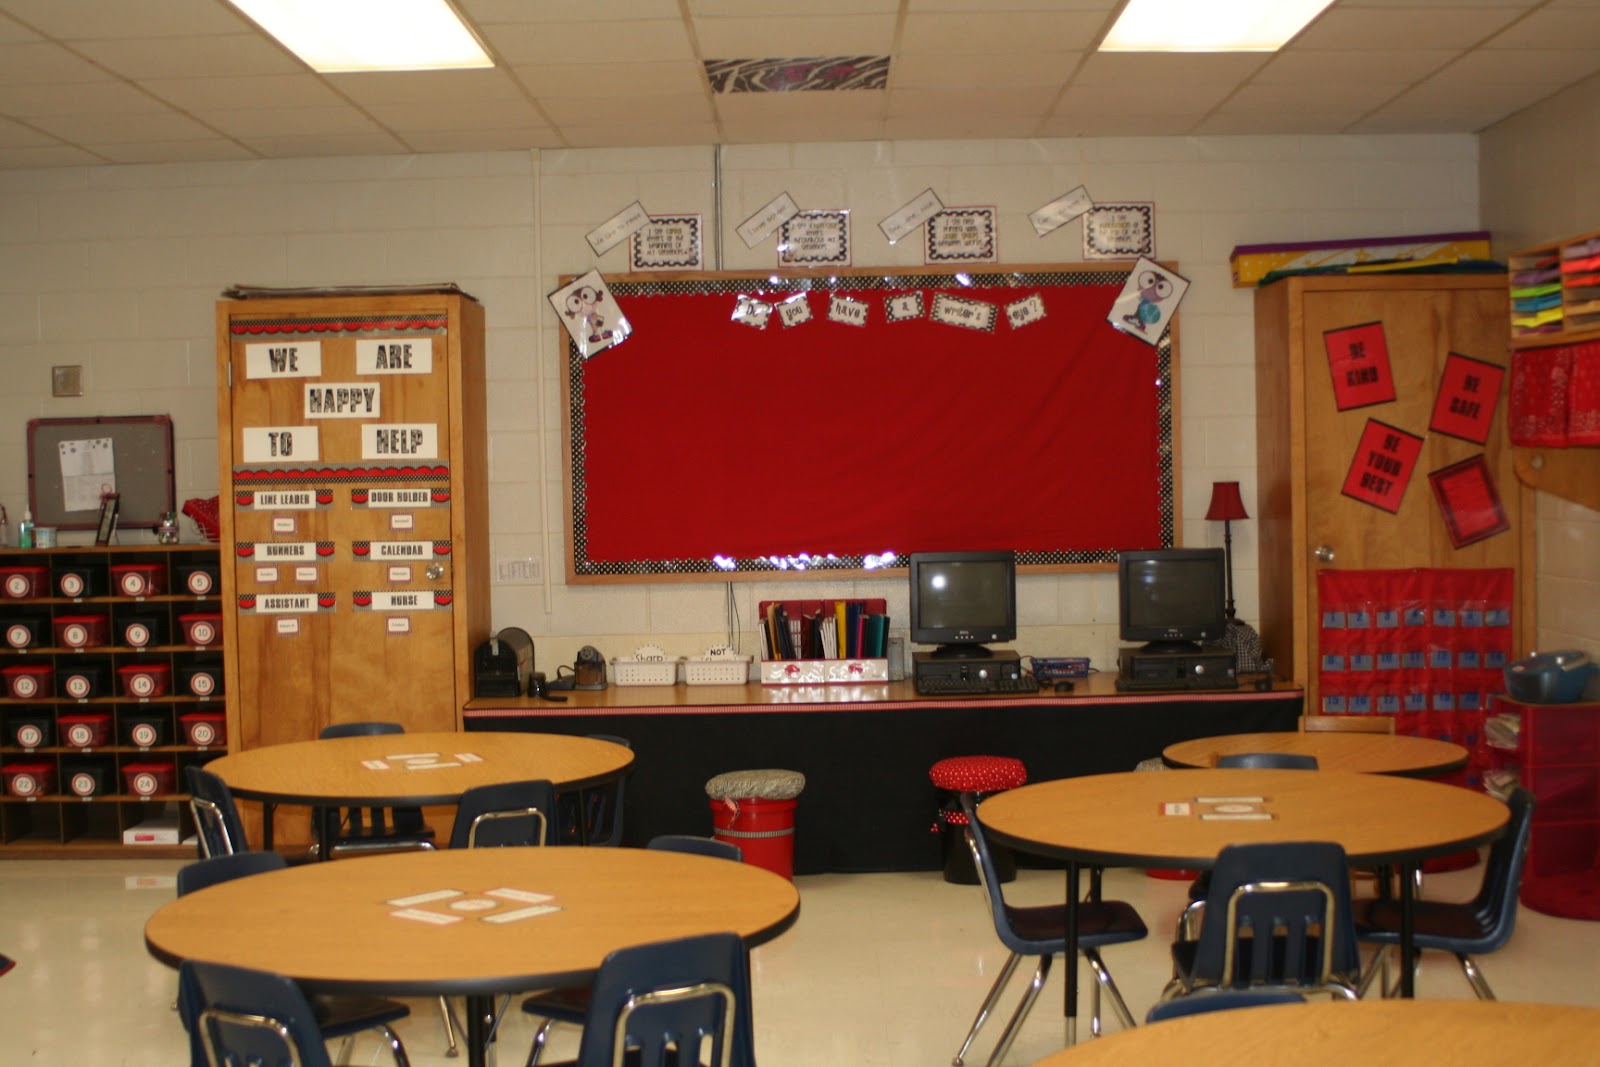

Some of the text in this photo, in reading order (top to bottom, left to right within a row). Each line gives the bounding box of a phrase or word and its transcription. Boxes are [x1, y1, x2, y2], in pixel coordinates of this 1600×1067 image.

[785, 305, 803, 321] you
[835, 302, 860, 319] have
[901, 300, 910, 312] a
[943, 304, 982, 322] writer's
[1349, 342, 1366, 359] BE
[268, 344, 413, 373] WE ARE
[1346, 367, 1378, 386] KIND
[1464, 375, 1480, 392] BE
[309, 388, 375, 413] HAPPY
[1450, 397, 1481, 419] SAFE
[268, 429, 423, 457] TO HELP
[1384, 434, 1400, 452] BE
[1367, 451, 1402, 477] YOUR
[1360, 472, 1393, 496] BEST
[260, 493, 310, 505] LINE LEADER
[371, 491, 429, 503] DOOR HOLDER
[266, 544, 305, 556] RUNNERS
[380, 544, 424, 556] CALENDAR
[196, 578, 203, 587] 5
[264, 597, 310, 609] ASSISTANT
[390, 594, 418, 606] NURSE
[72, 631, 79, 640] 8
[134, 631, 141, 640] 9
[198, 628, 208, 637] 10
[710, 648, 727, 656] NOT
[635, 653, 664, 663] Sharp
[21, 682, 30, 691] 12
[73, 682, 83, 691] 13
[137, 680, 147, 689] 14
[198, 679, 208, 688] 15
[24, 732, 35, 741] 17
[75, 731, 85, 740] 18
[139, 731, 149, 740] 19
[197, 729, 208, 738] 20
[18, 779, 29, 789] 22
[77, 779, 88, 789] 23
[140, 779, 151, 789] 24
